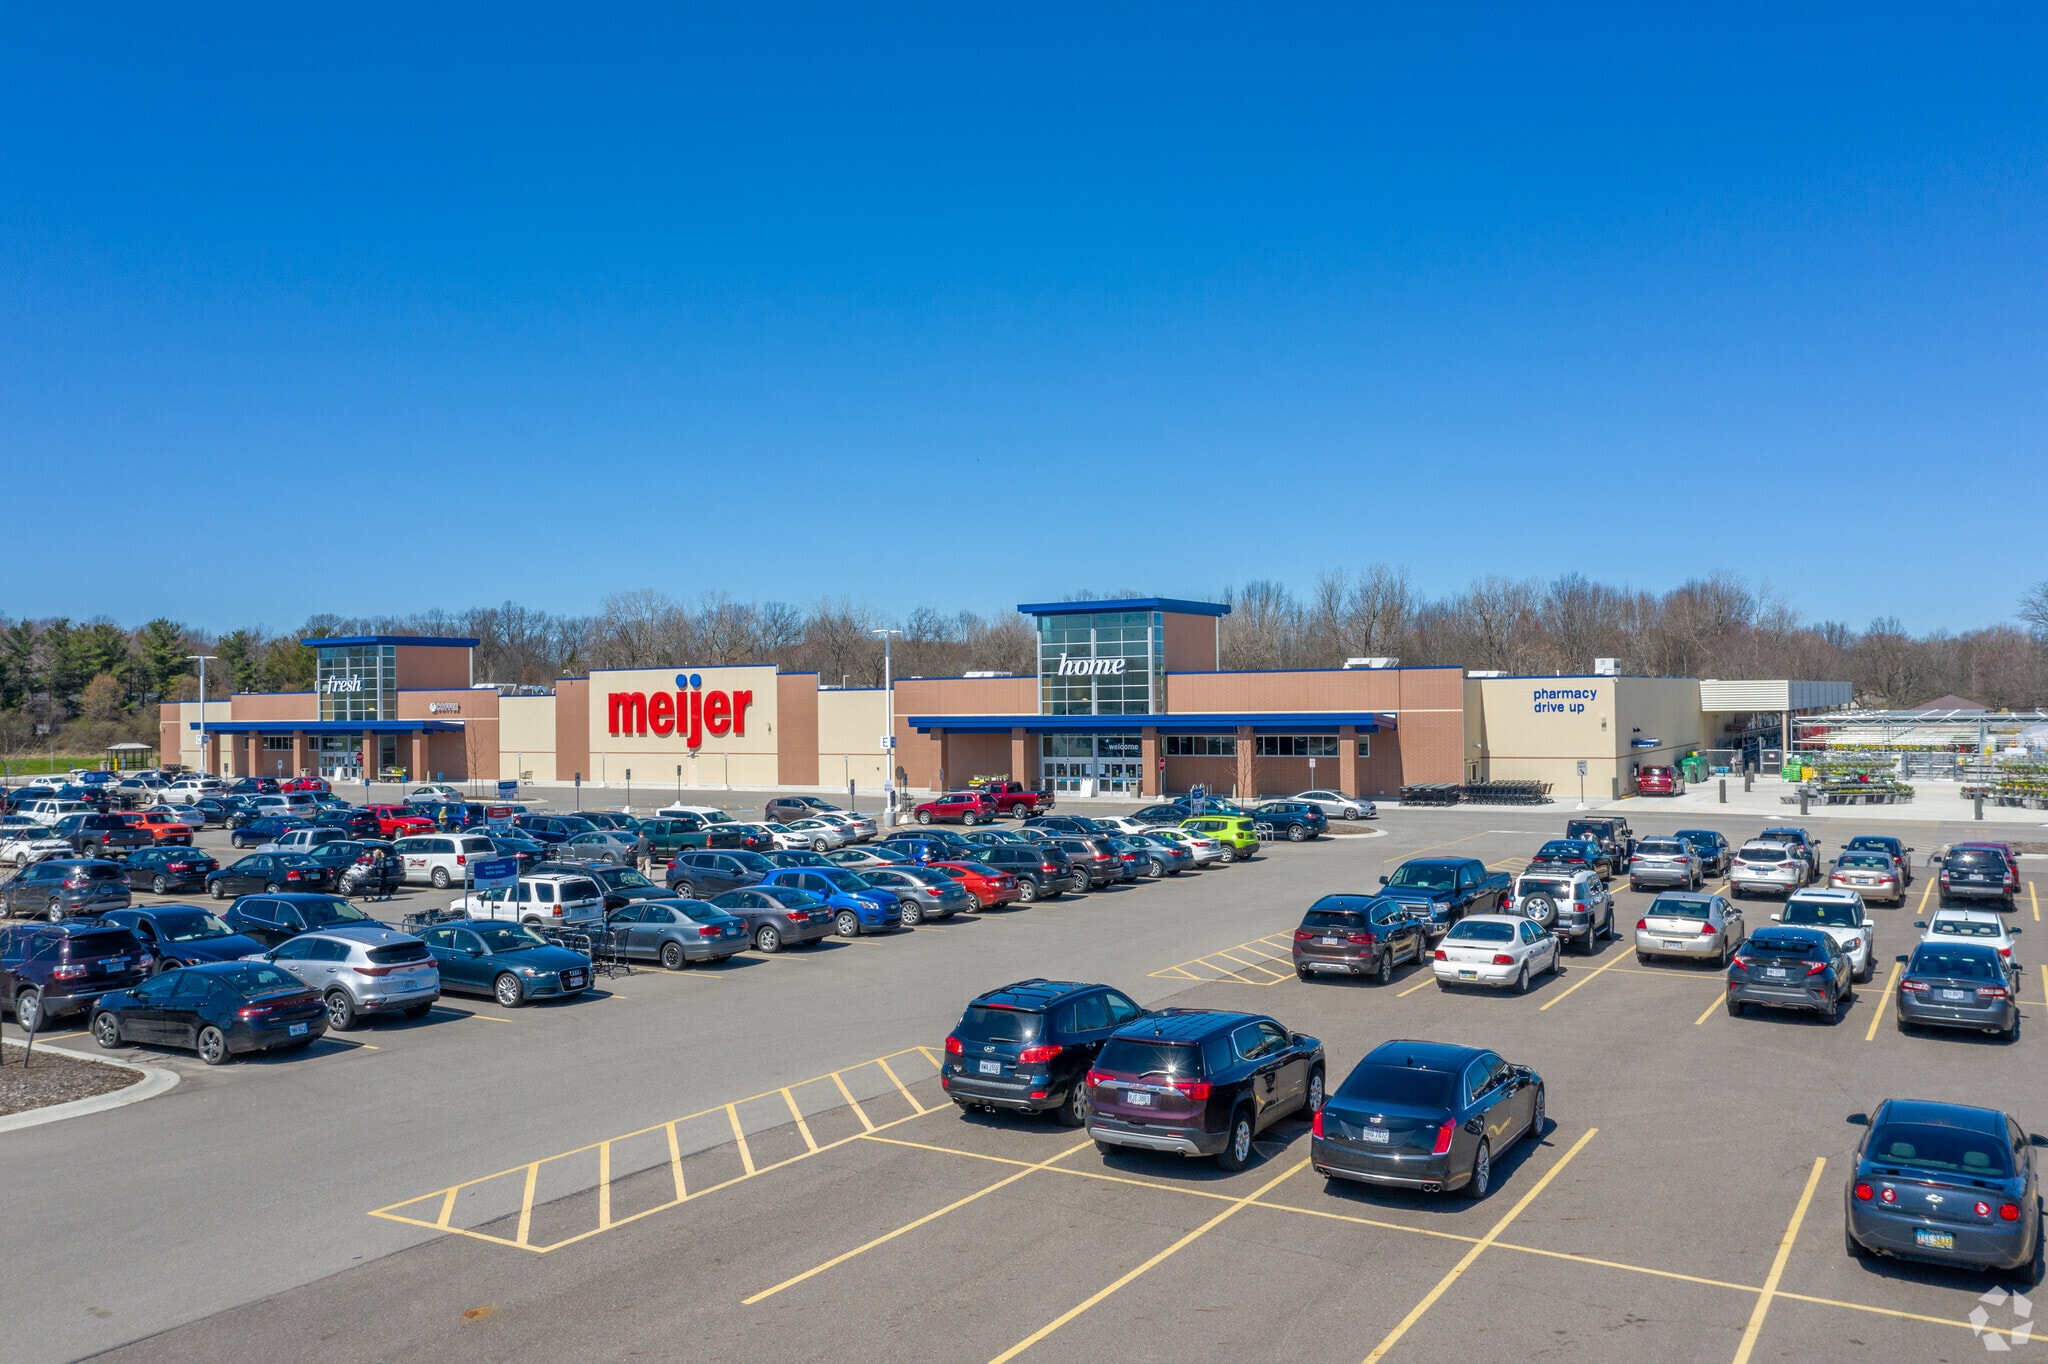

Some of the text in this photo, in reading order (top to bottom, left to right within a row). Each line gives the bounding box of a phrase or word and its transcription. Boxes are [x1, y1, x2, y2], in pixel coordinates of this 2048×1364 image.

[1058, 653, 1126, 676] home
[327, 674, 362, 694] fresh
[1533, 688, 1597, 701] pharmacy
[608, 673, 753, 749] meijer
[1534, 702, 1585, 714] drive up
[1108, 743, 1139, 751] welcome
